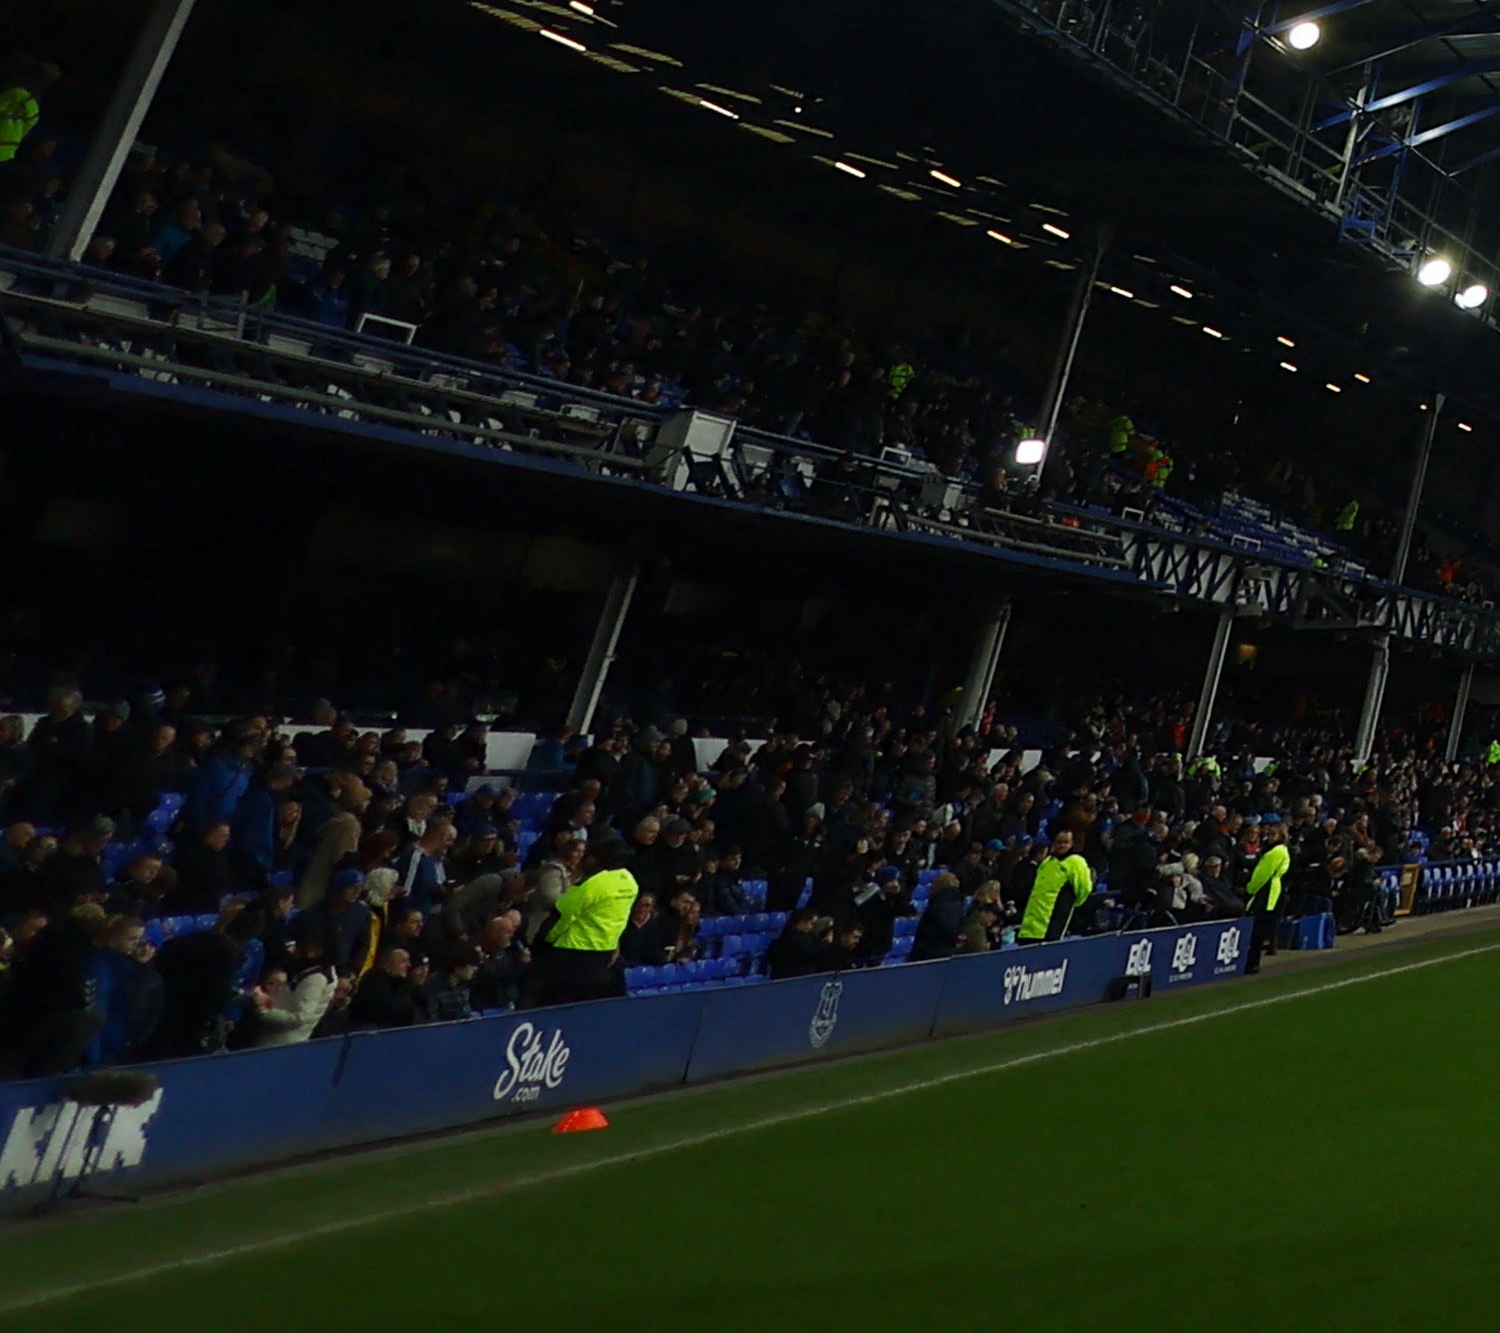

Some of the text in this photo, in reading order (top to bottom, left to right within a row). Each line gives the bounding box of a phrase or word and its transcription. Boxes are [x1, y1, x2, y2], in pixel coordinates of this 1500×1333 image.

[1015, 957, 1069, 1002] hummel
[493, 1021, 571, 1100] Stake
[510, 1084, 541, 1103] .com
